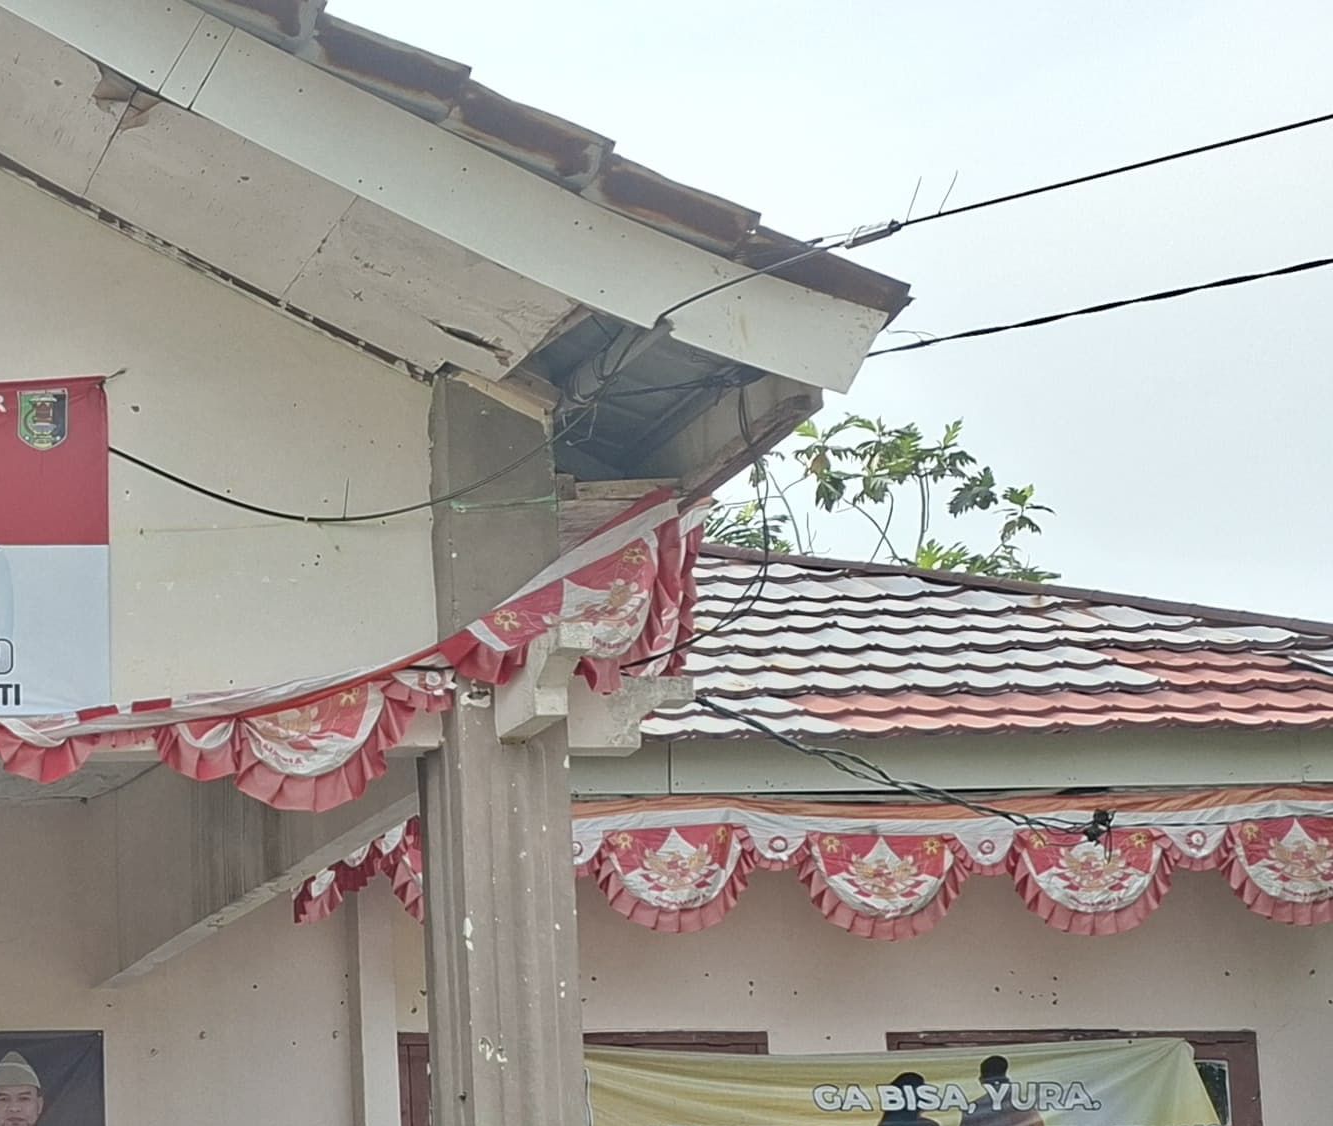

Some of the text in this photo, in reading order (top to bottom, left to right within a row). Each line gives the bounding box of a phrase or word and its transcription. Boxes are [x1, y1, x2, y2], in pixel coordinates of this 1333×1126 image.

[813, 1082, 1101, 1115] GA BISA, YURA.
